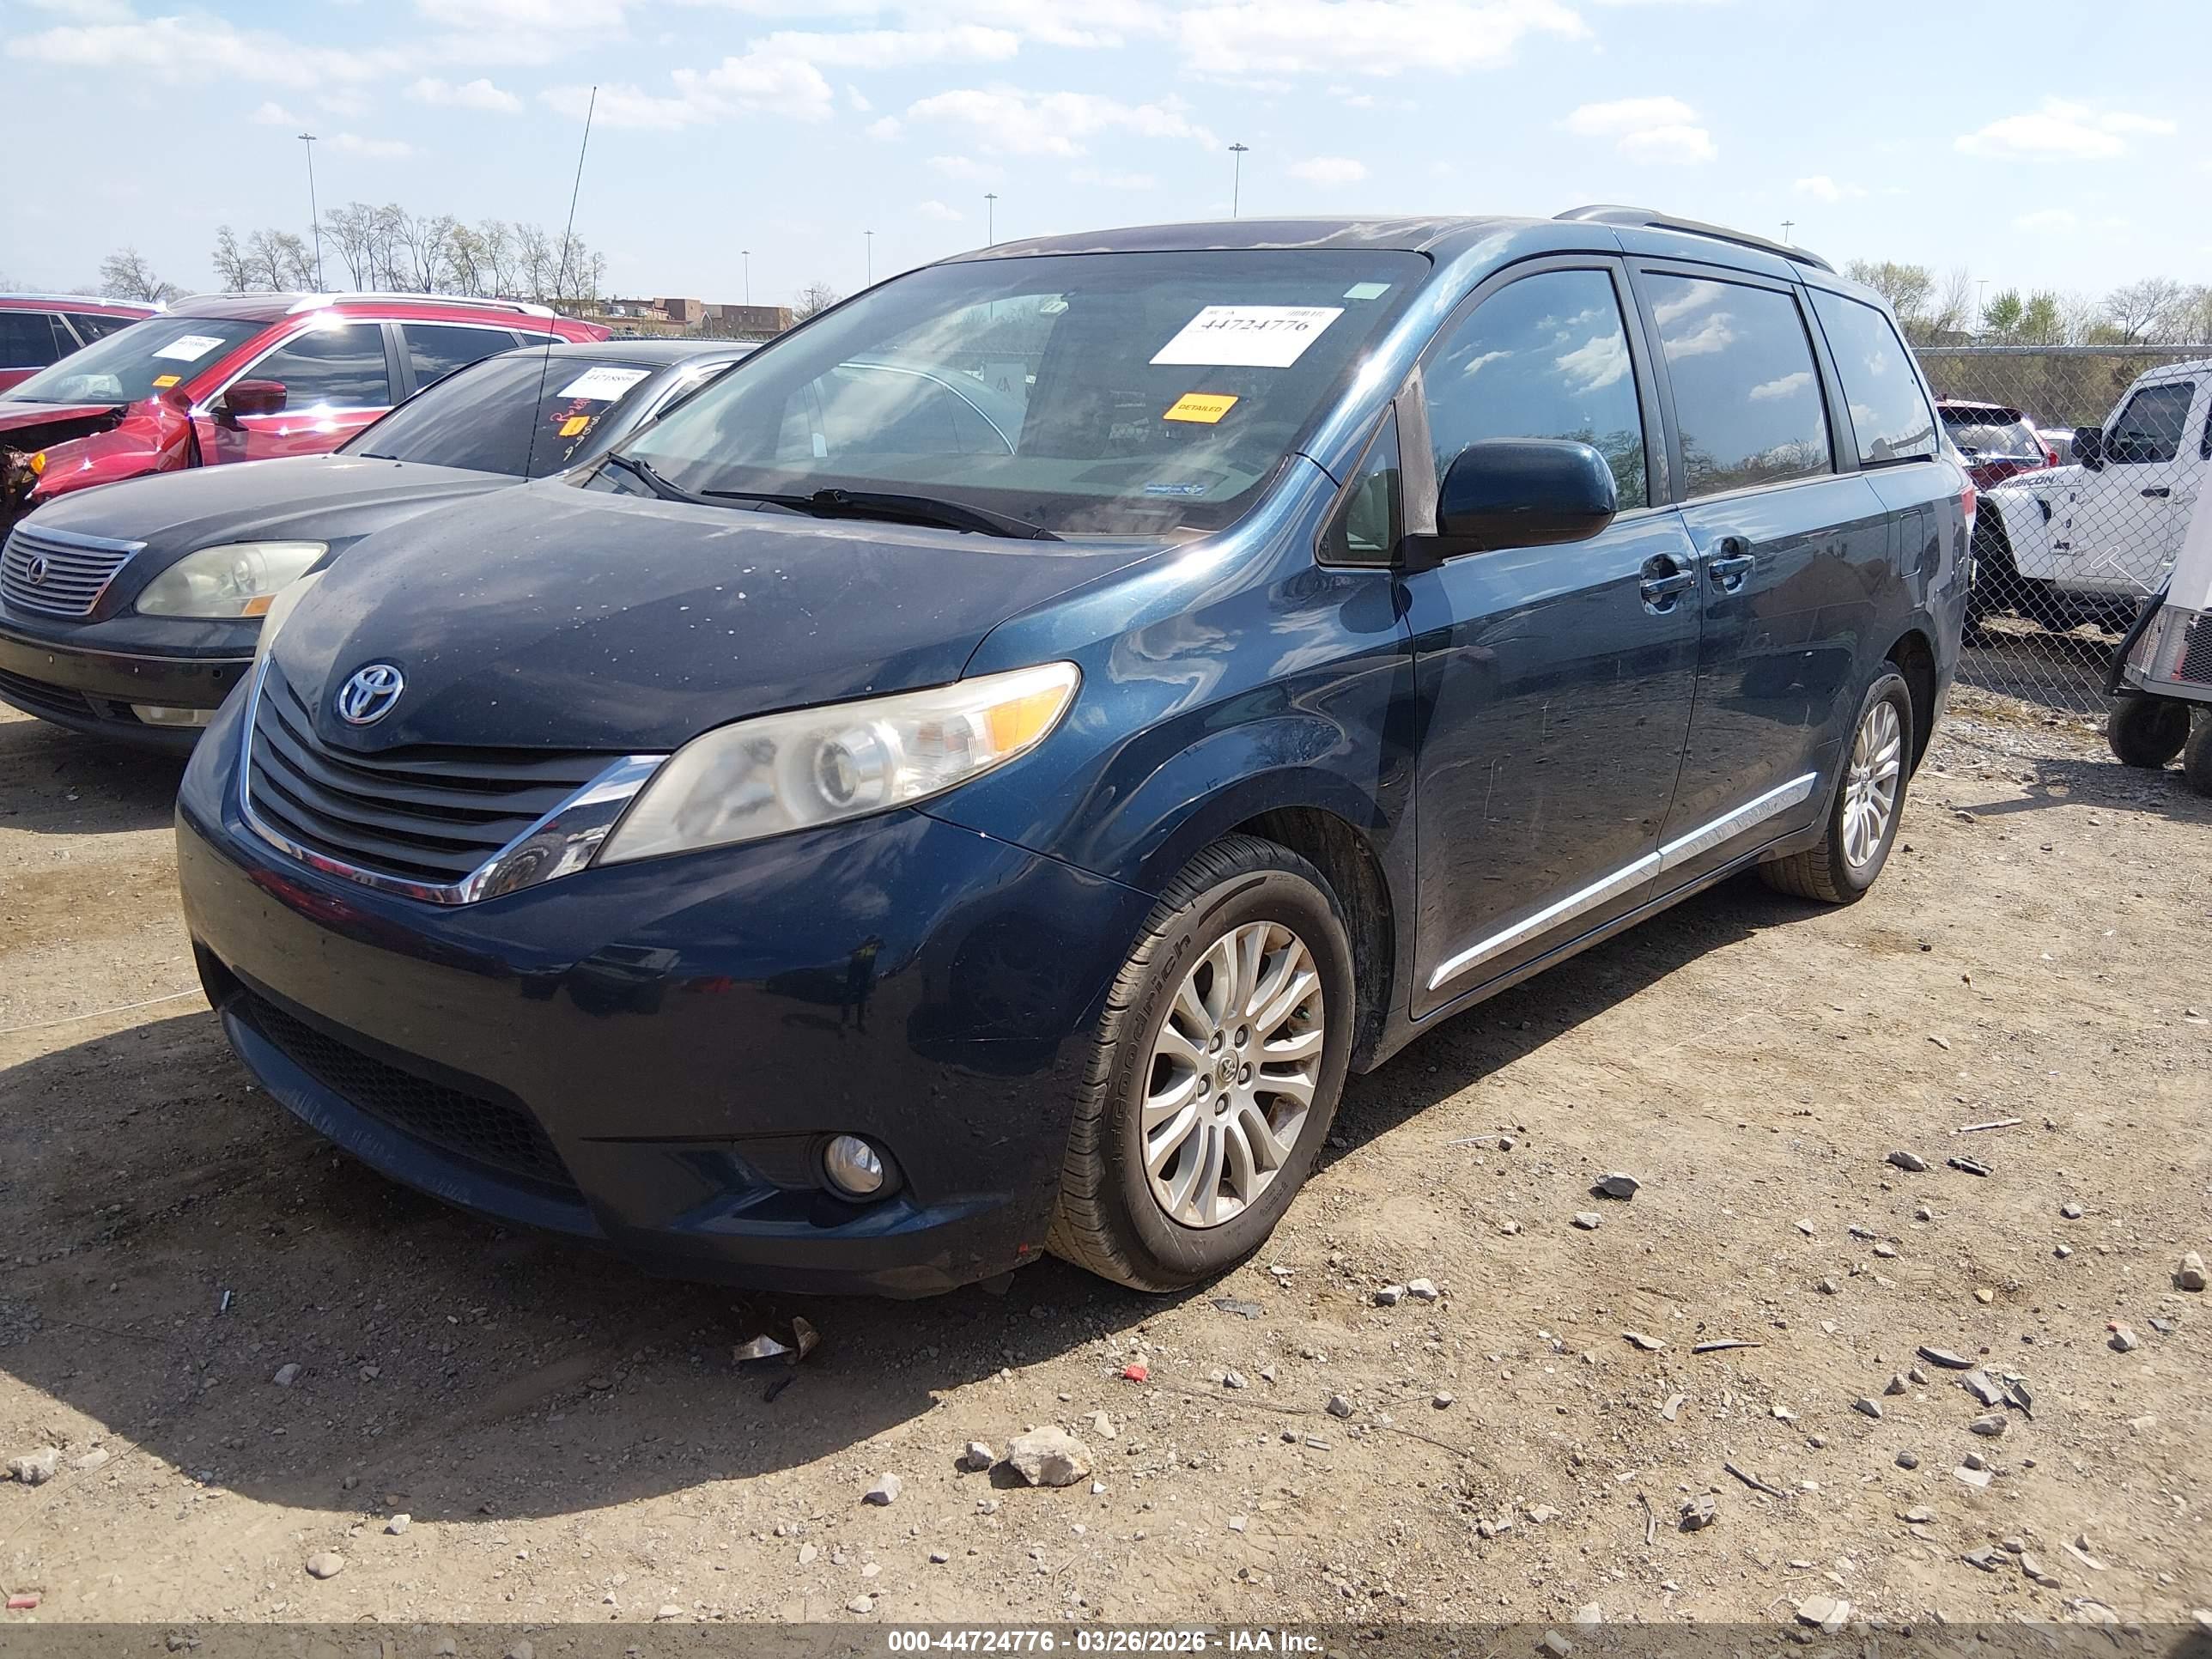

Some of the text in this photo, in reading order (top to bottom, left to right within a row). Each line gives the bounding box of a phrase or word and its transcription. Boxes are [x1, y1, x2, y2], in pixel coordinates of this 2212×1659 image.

[1201, 319, 1310, 331] 44724776
[1178, 404, 1223, 413] DETAILED
[2000, 476, 2055, 489] RUBICON
